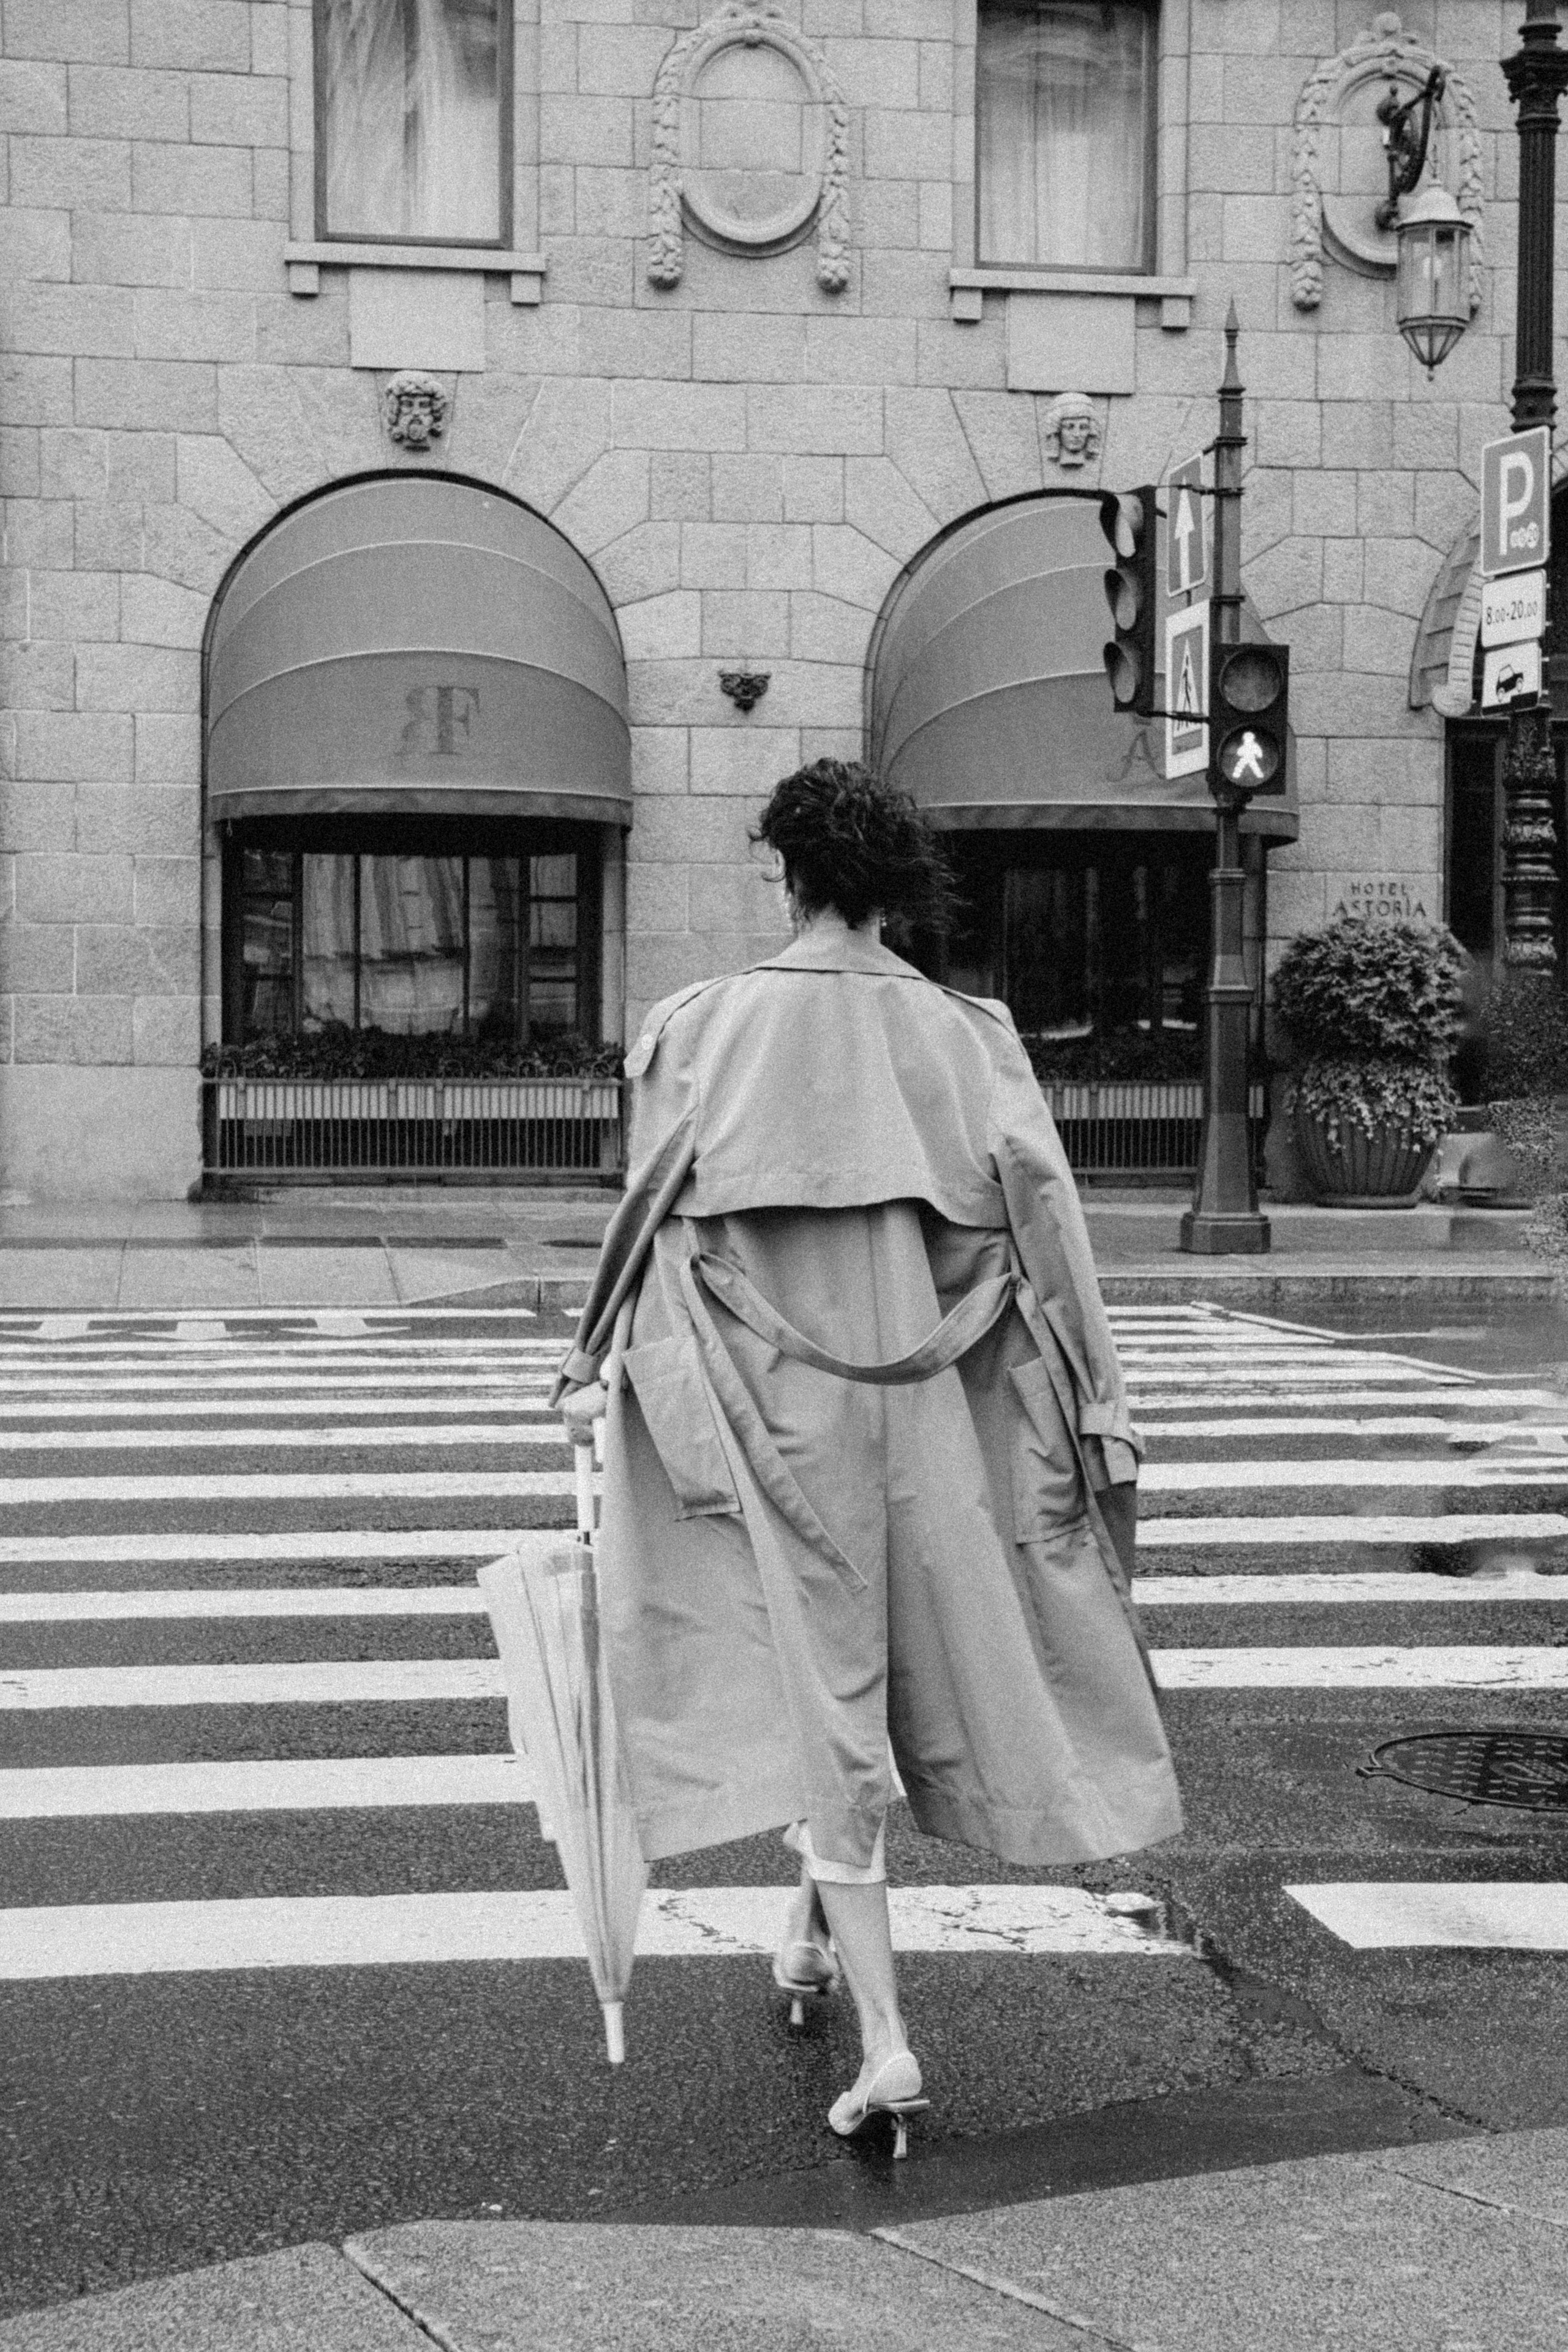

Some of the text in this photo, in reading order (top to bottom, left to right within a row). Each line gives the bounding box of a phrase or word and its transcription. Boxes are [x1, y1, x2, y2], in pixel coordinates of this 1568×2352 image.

[1499, 451, 1533, 556] P
[1351, 882, 1407, 895] HOTEL
[1332, 899, 1427, 919] ASTORIA
